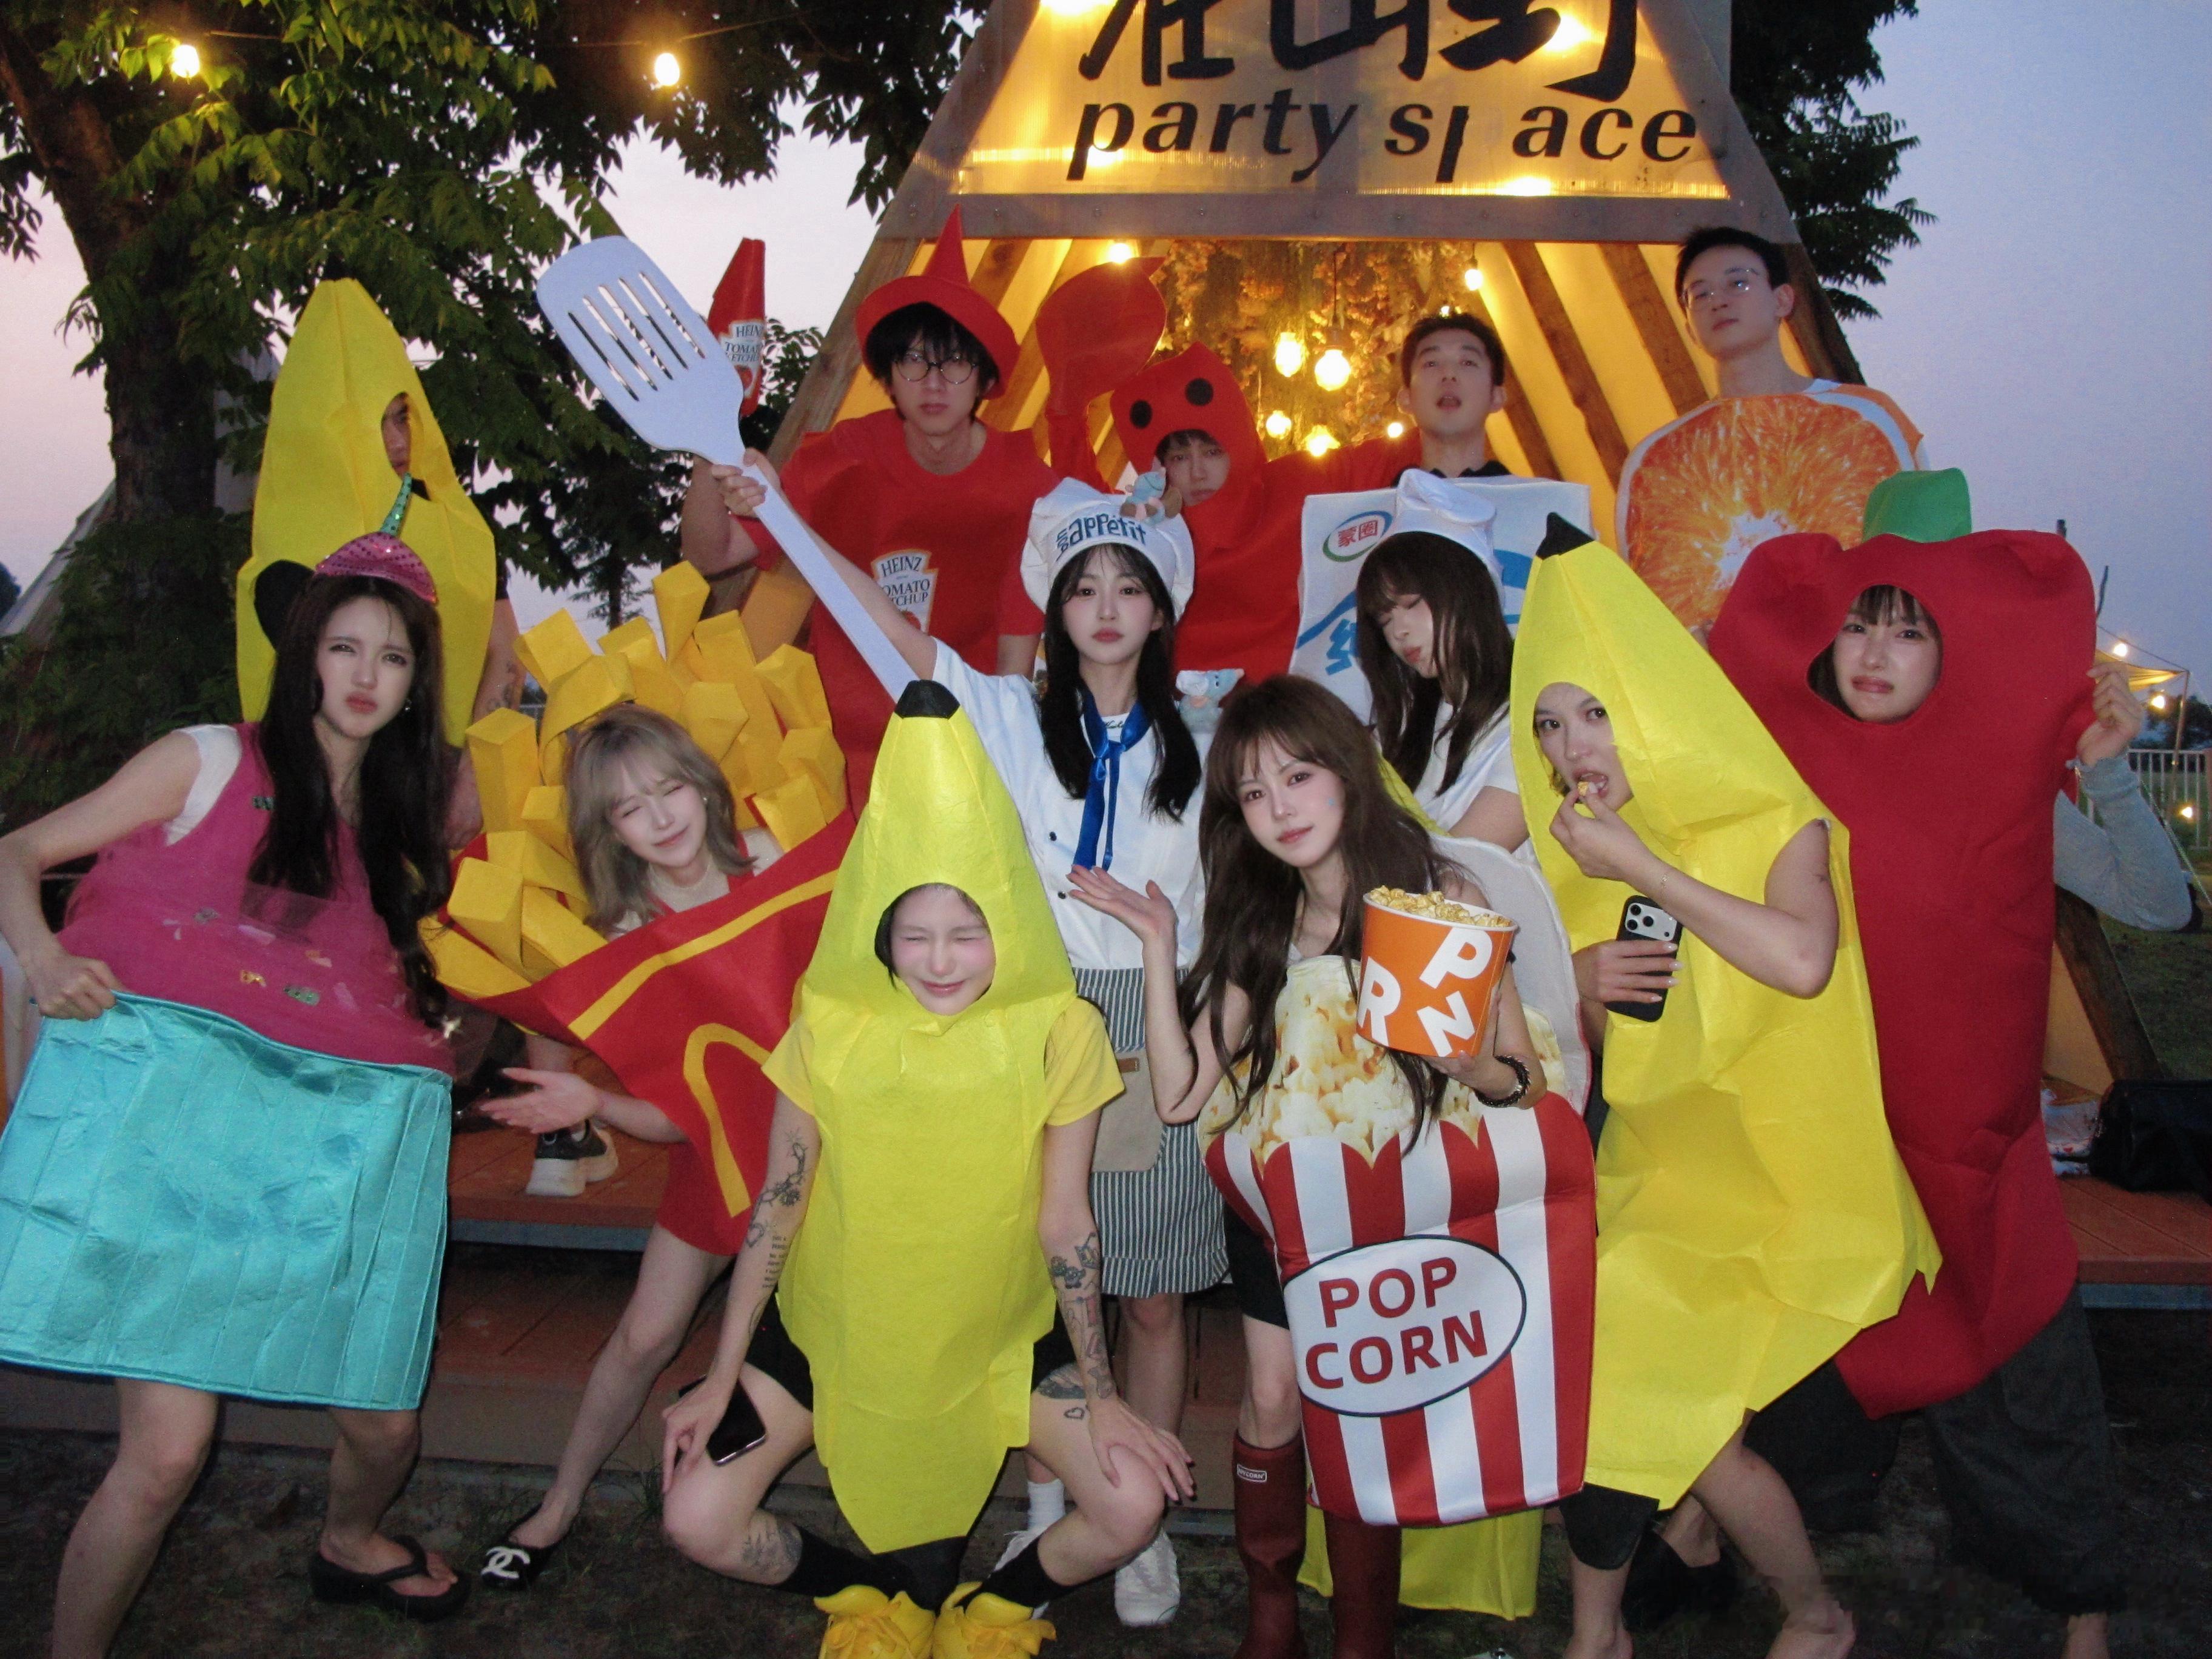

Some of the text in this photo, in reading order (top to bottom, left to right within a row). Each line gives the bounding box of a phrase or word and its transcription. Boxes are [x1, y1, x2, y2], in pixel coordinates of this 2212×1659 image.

[1067, 89, 1359, 183] party
[881, 555, 922, 577] HEINZ
[882, 578, 930, 596] OMATO
[1319, 1256, 1456, 1328] POP
[1305, 1310, 1488, 1389] CORN
